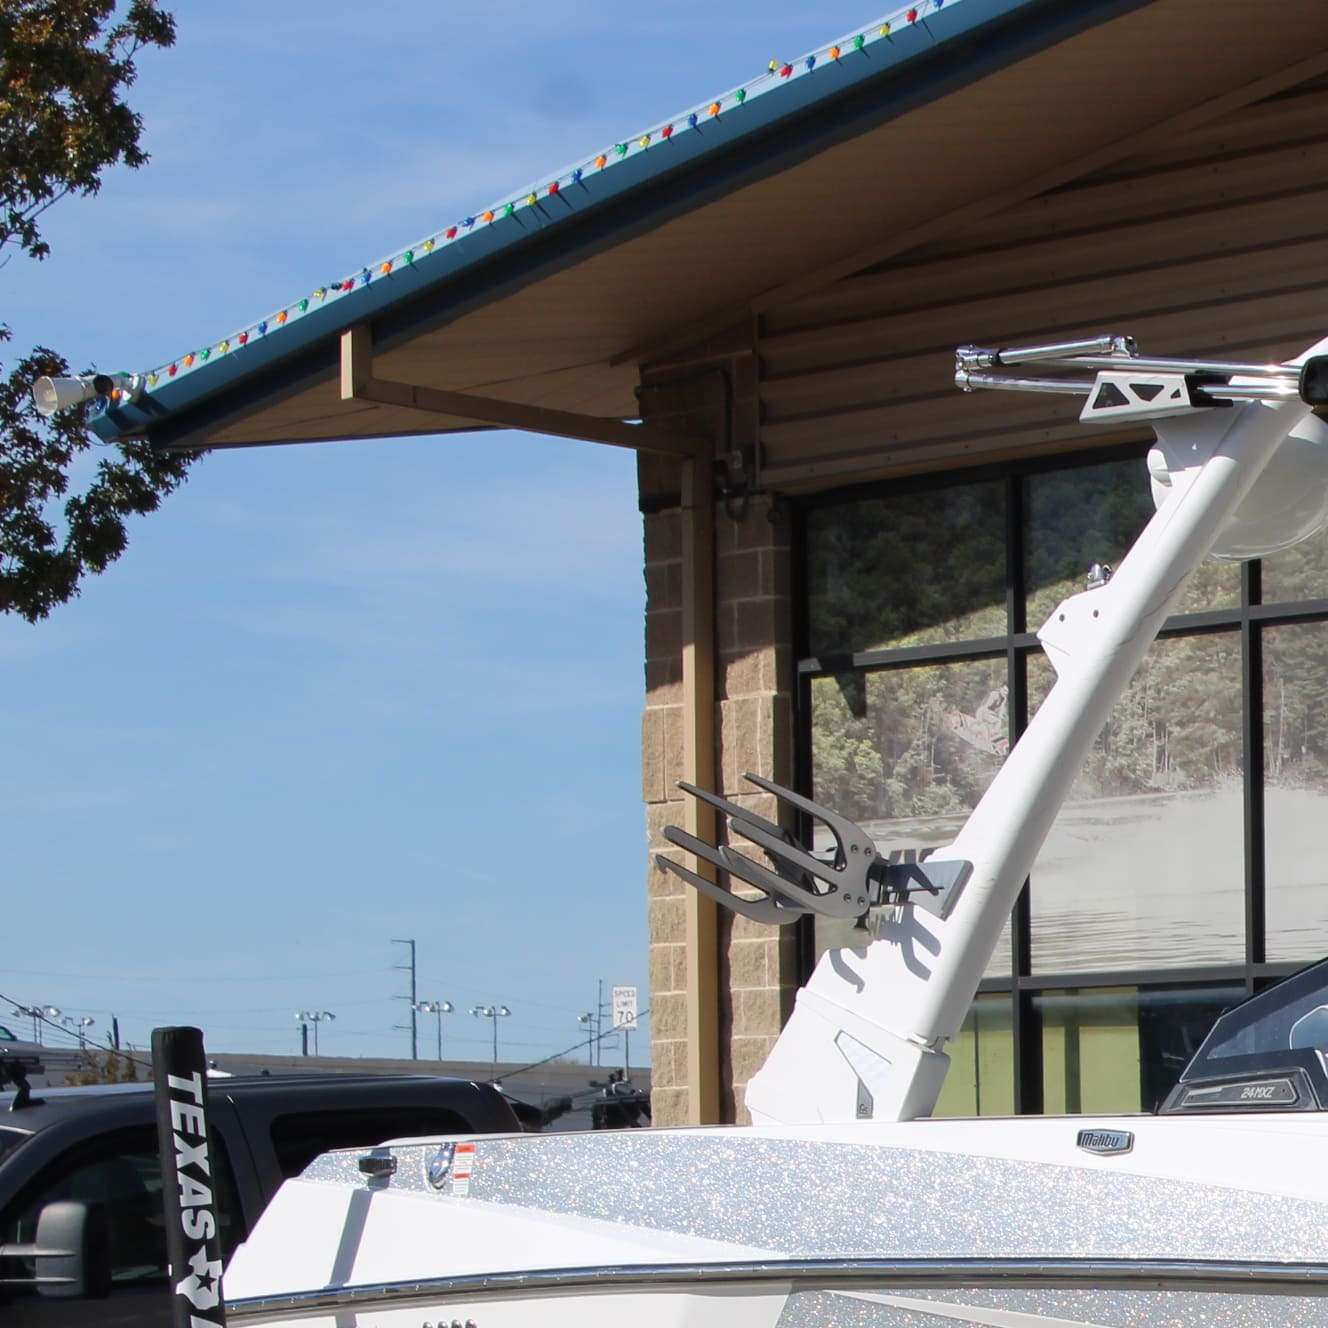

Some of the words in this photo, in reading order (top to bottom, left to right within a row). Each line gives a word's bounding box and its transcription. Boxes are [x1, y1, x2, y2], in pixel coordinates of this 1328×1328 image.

[617, 1010, 634, 1023] 70
[1082, 1133, 1120, 1147] Malibu
[168, 1071, 216, 1240] TEXAS
